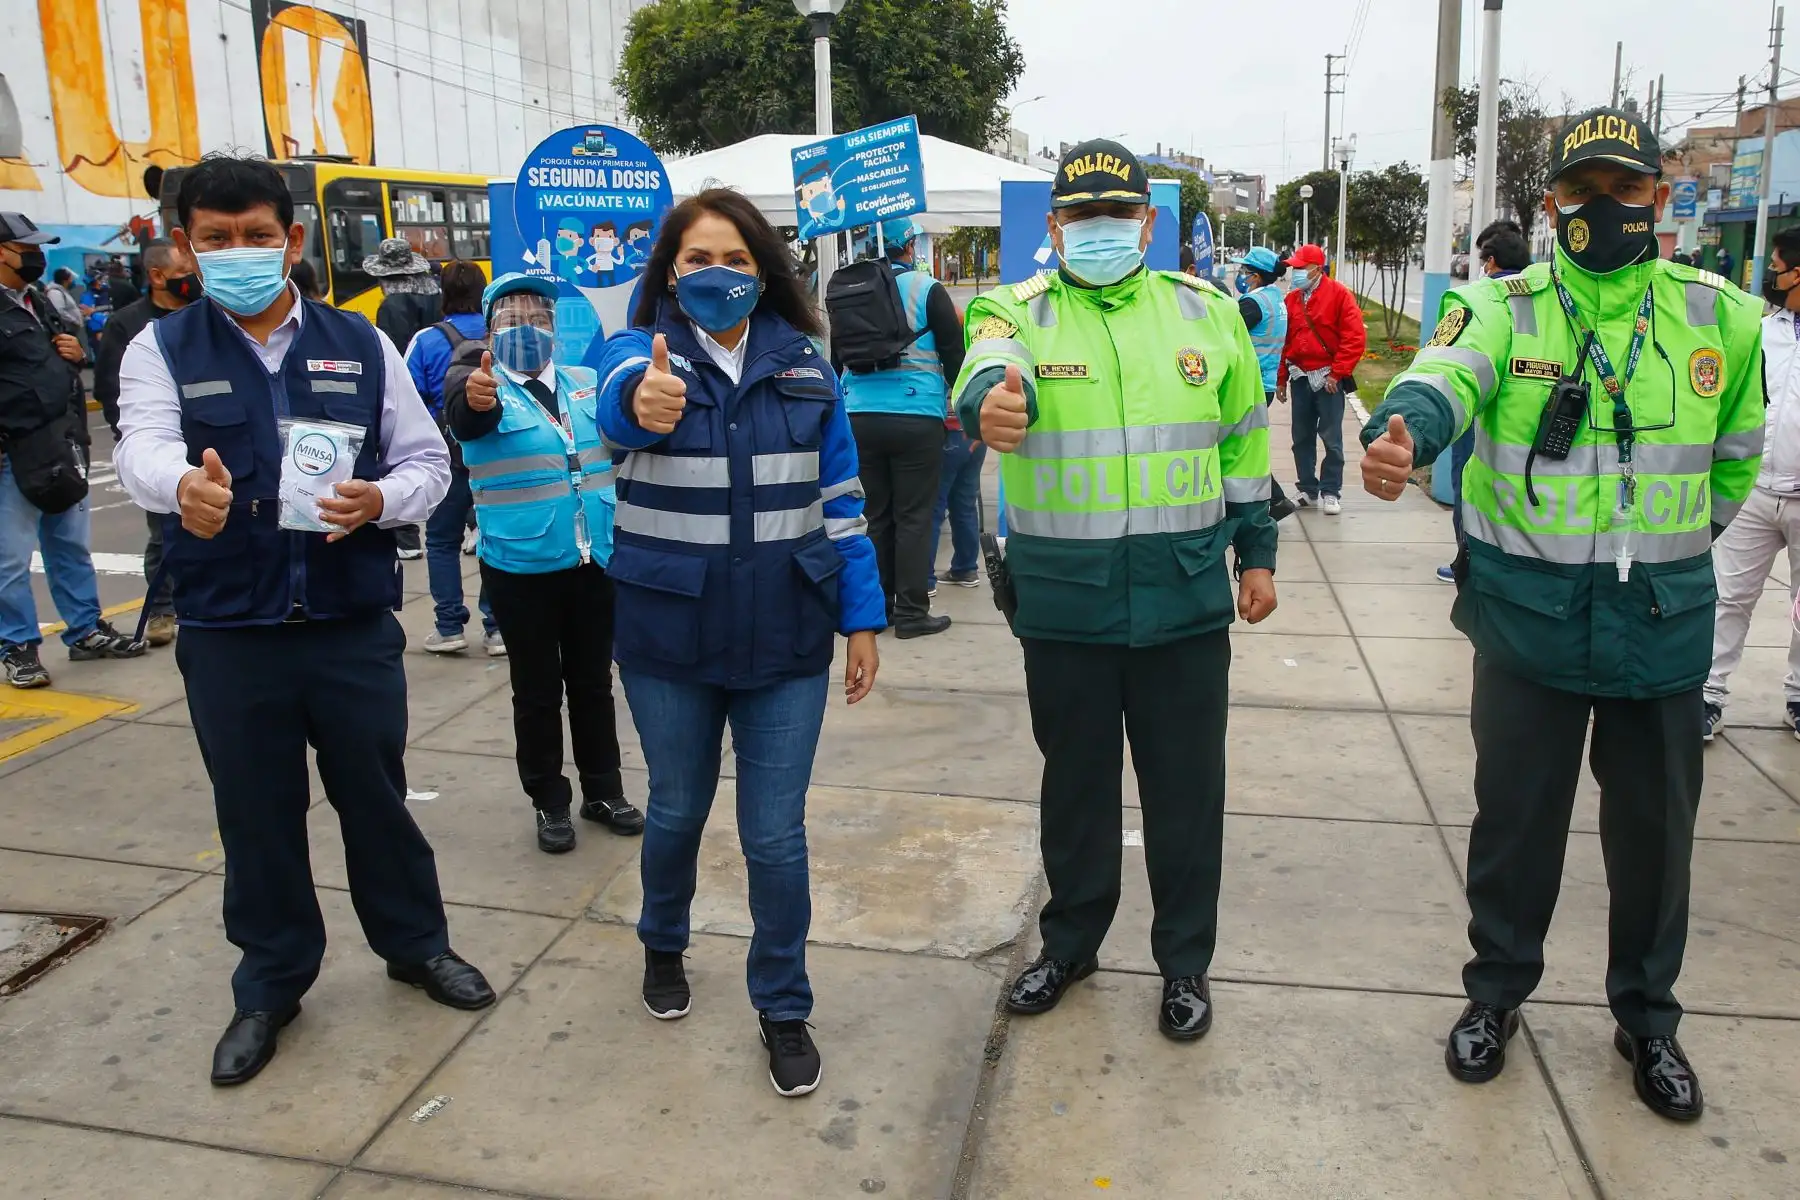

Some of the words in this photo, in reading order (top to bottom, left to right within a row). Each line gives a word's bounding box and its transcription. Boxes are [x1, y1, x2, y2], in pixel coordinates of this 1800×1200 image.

[847, 135, 867, 147] USA
[867, 122, 910, 142] SIEMPRE
[1562, 114, 1640, 161] POLICIA
[855, 141, 906, 161] PROTECTOR
[863, 155, 892, 168] FACIAL
[893, 152, 899, 160] Y
[540, 157, 572, 166] PORQUE
[573, 158, 585, 166] NO
[586, 159, 601, 167] HAY
[602, 160, 634, 168] PRIMERA
[1064, 152, 1131, 182] POLICIA
[527, 167, 607, 189] SEGUNDA
[612, 169, 660, 190] DOSIS
[856, 163, 910, 183] MASCARILLA
[868, 177, 907, 191] OBLIGATORIO
[539, 192, 623, 210] ¡VACÚNATE
[626, 196, 649, 209] YA!
[863, 193, 888, 211] Covid
[876, 198, 916, 217] conmigo
[1623, 222, 1649, 233] POLICIA
[297, 443, 332, 463] MINSA
[1035, 456, 1214, 505] POLICIA
